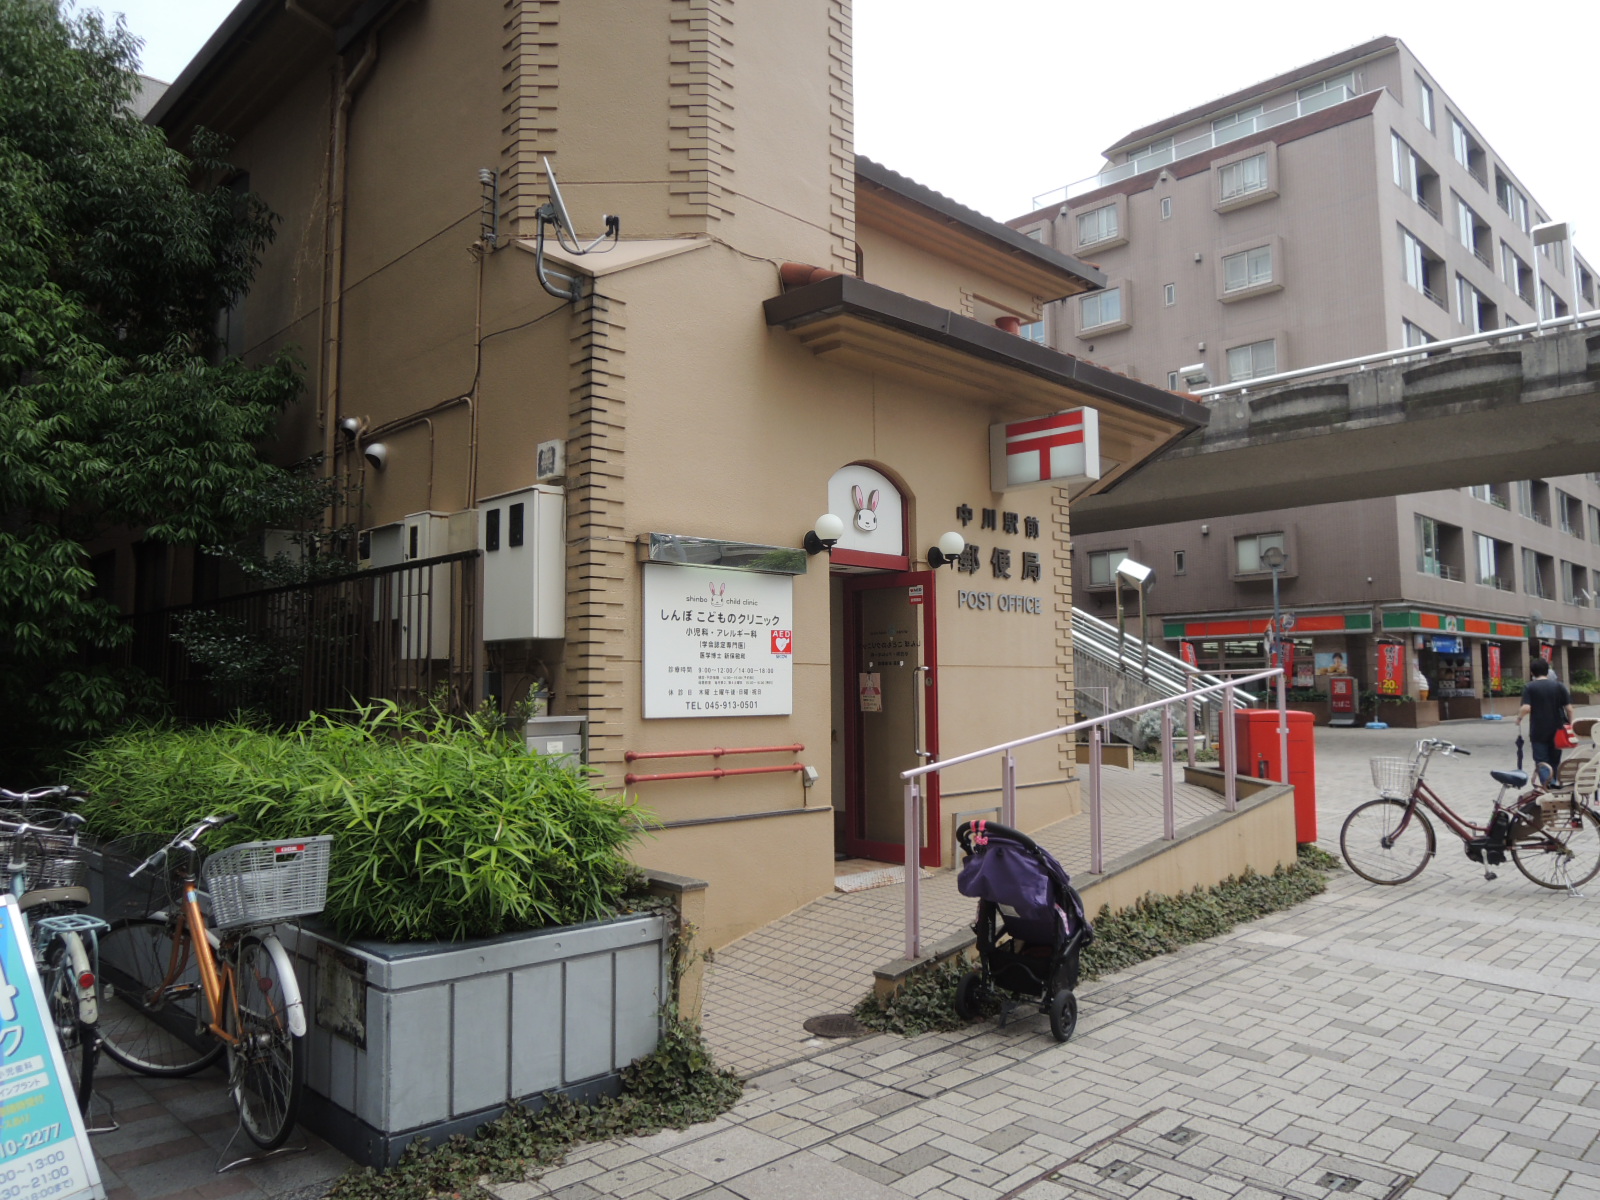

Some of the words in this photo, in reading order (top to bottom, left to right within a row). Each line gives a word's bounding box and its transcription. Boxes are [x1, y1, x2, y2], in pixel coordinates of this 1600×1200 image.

[956, 503, 1039, 539] 中川駅前
[958, 543, 1041, 582] 郵便局
[686, 595, 708, 603] shinbo
[958, 590, 994, 610] POST
[998, 594, 1041, 614] OFFICE
[661, 608, 693, 621] しんぼ
[697, 611, 780, 626] こどものクリニック
[772, 630, 791, 638] AED
[1333, 681, 1346, 694] 酒
[686, 701, 702, 710] TEL
[705, 700, 758, 710] 045-913-0501
[1332, 700, 1351, 708] たばこ
